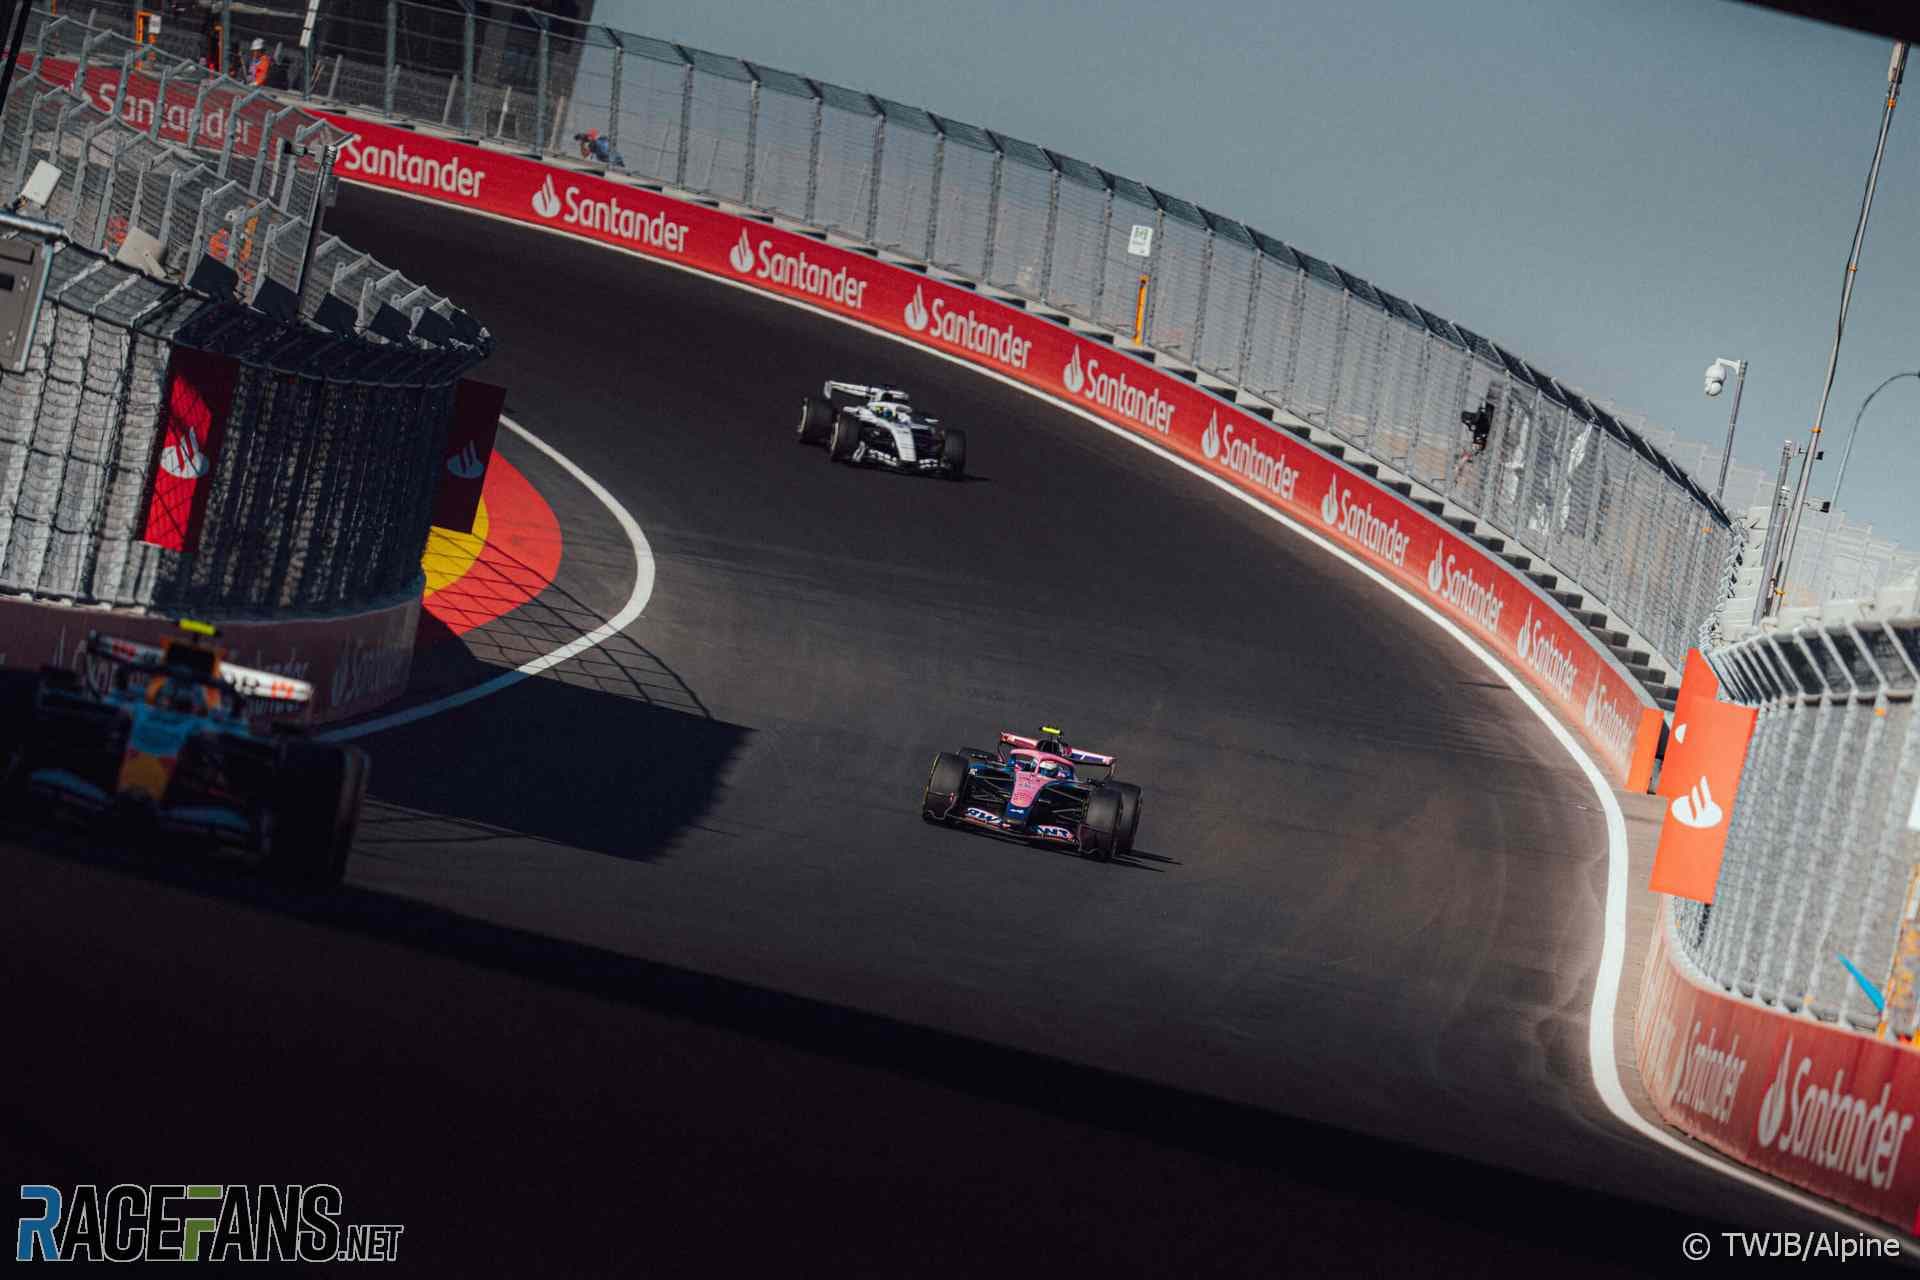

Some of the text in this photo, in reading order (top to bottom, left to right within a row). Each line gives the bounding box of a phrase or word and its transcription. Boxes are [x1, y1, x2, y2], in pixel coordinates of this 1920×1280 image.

[99, 84, 253, 145] Sanander
[346, 134, 485, 198] Santander
[563, 186, 689, 253] Santander
[756, 241, 867, 310] Santander
[929, 298, 1032, 370] Santander
[1084, 358, 1175, 434] Santander
[1220, 423, 1299, 500] Santander
[1338, 488, 1410, 567] Santander
[1441, 554, 1504, 632] Santander
[1779, 1056, 1914, 1190] Santander
